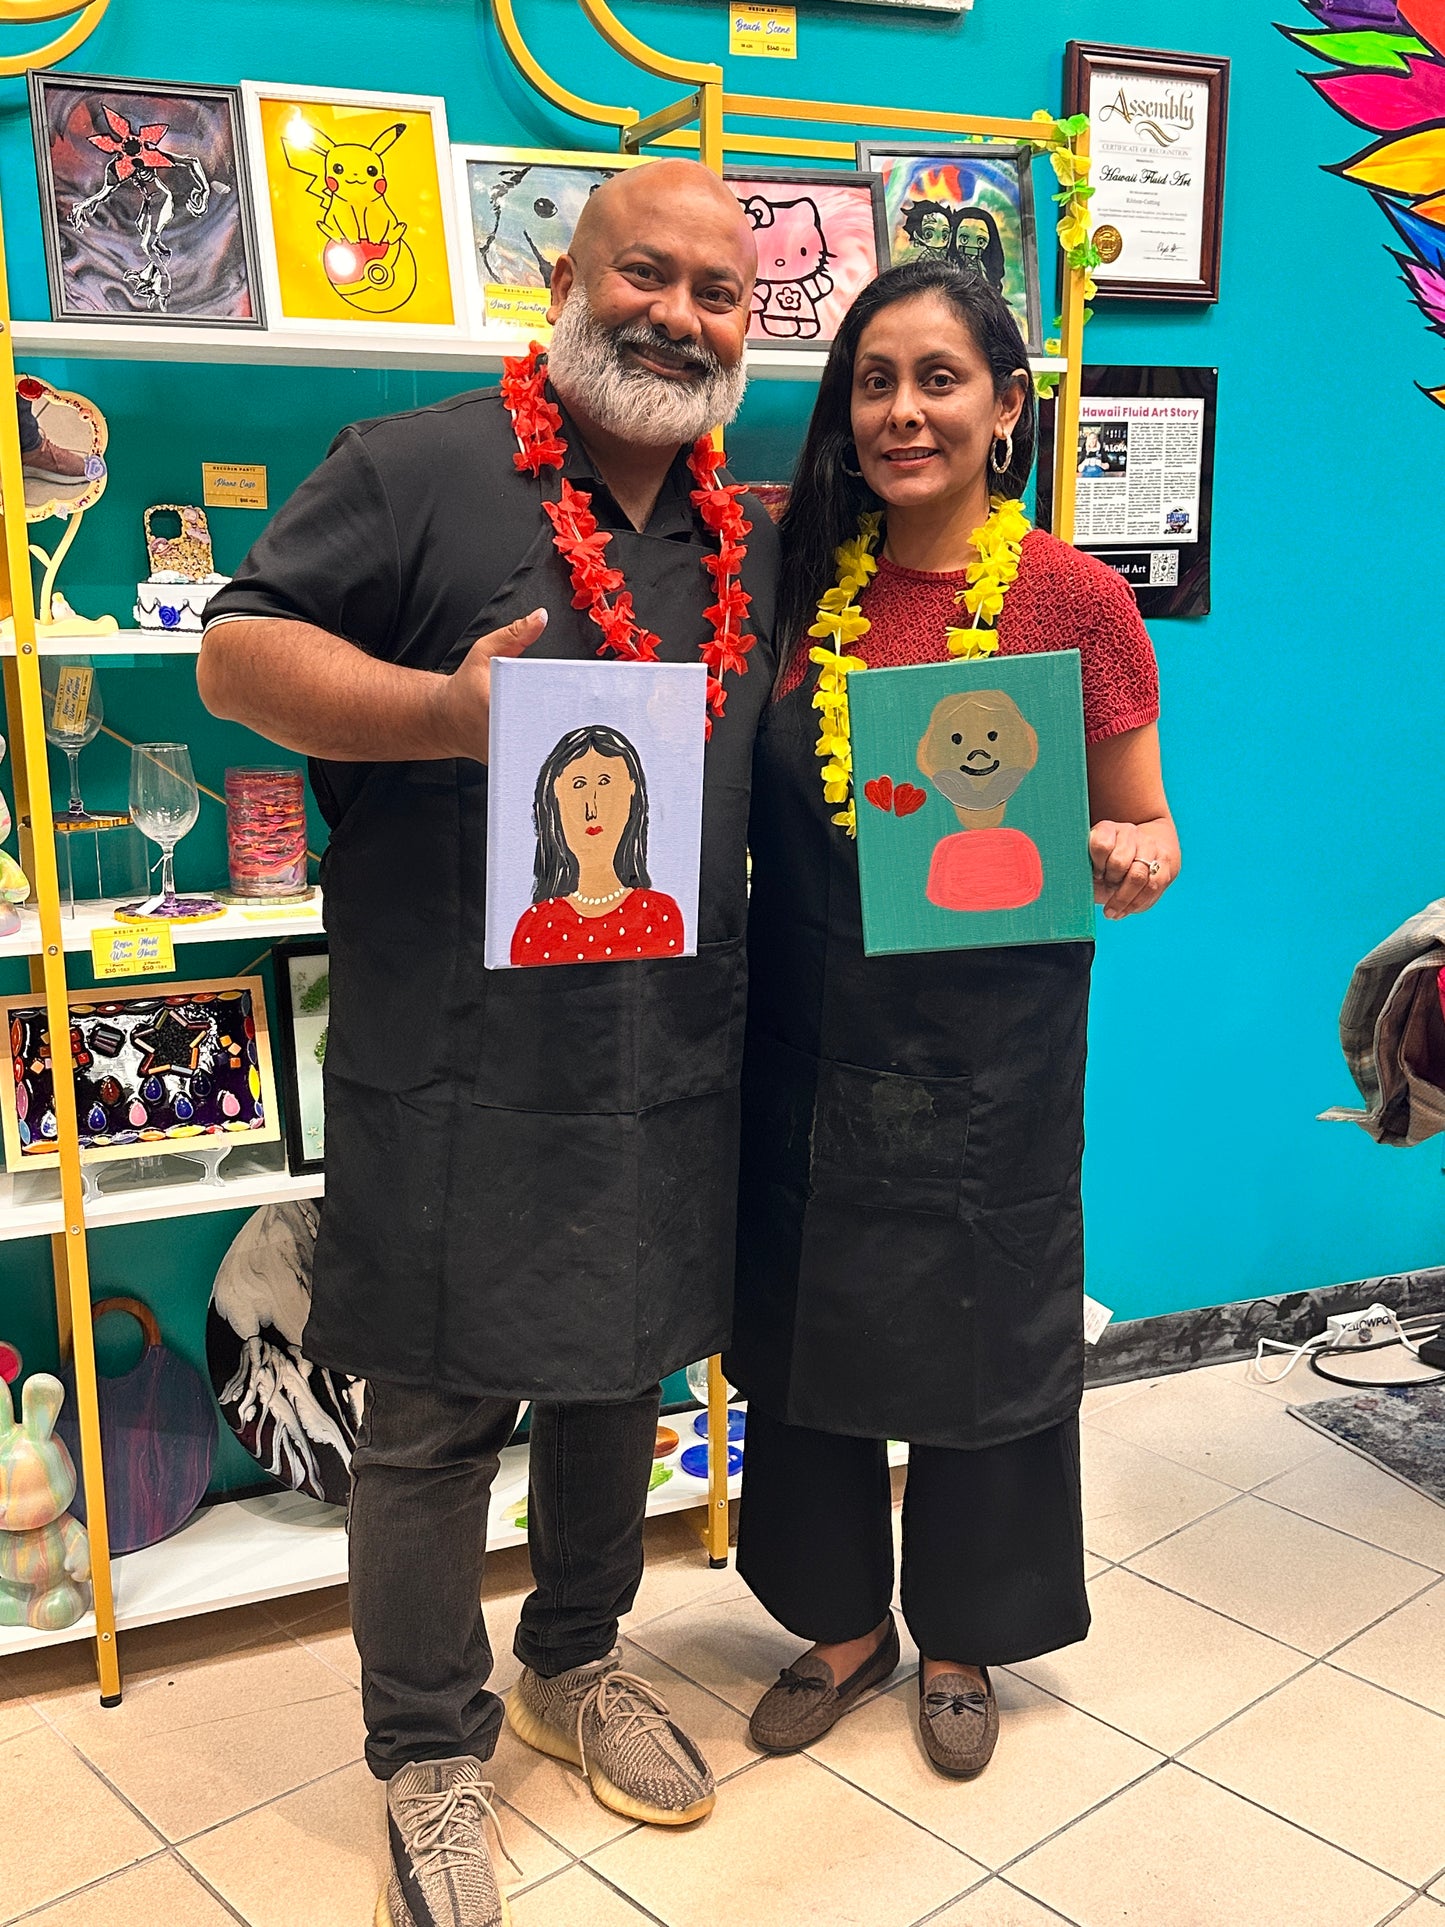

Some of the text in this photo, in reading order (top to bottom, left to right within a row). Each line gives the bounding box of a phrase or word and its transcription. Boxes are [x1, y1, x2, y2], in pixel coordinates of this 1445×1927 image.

[735, 18, 791, 35] Beach Scene
[1098, 87, 1194, 131] Assembly
[1102, 143, 1139, 153] CERTIFICATE
[1149, 147, 1189, 156] RECOGNITION
[1099, 164, 1192, 187] Hawaii Fluid Art
[1082, 406, 1199, 420] Hawaii Fluid Art Story
[1131, 564, 1147, 574] Art
